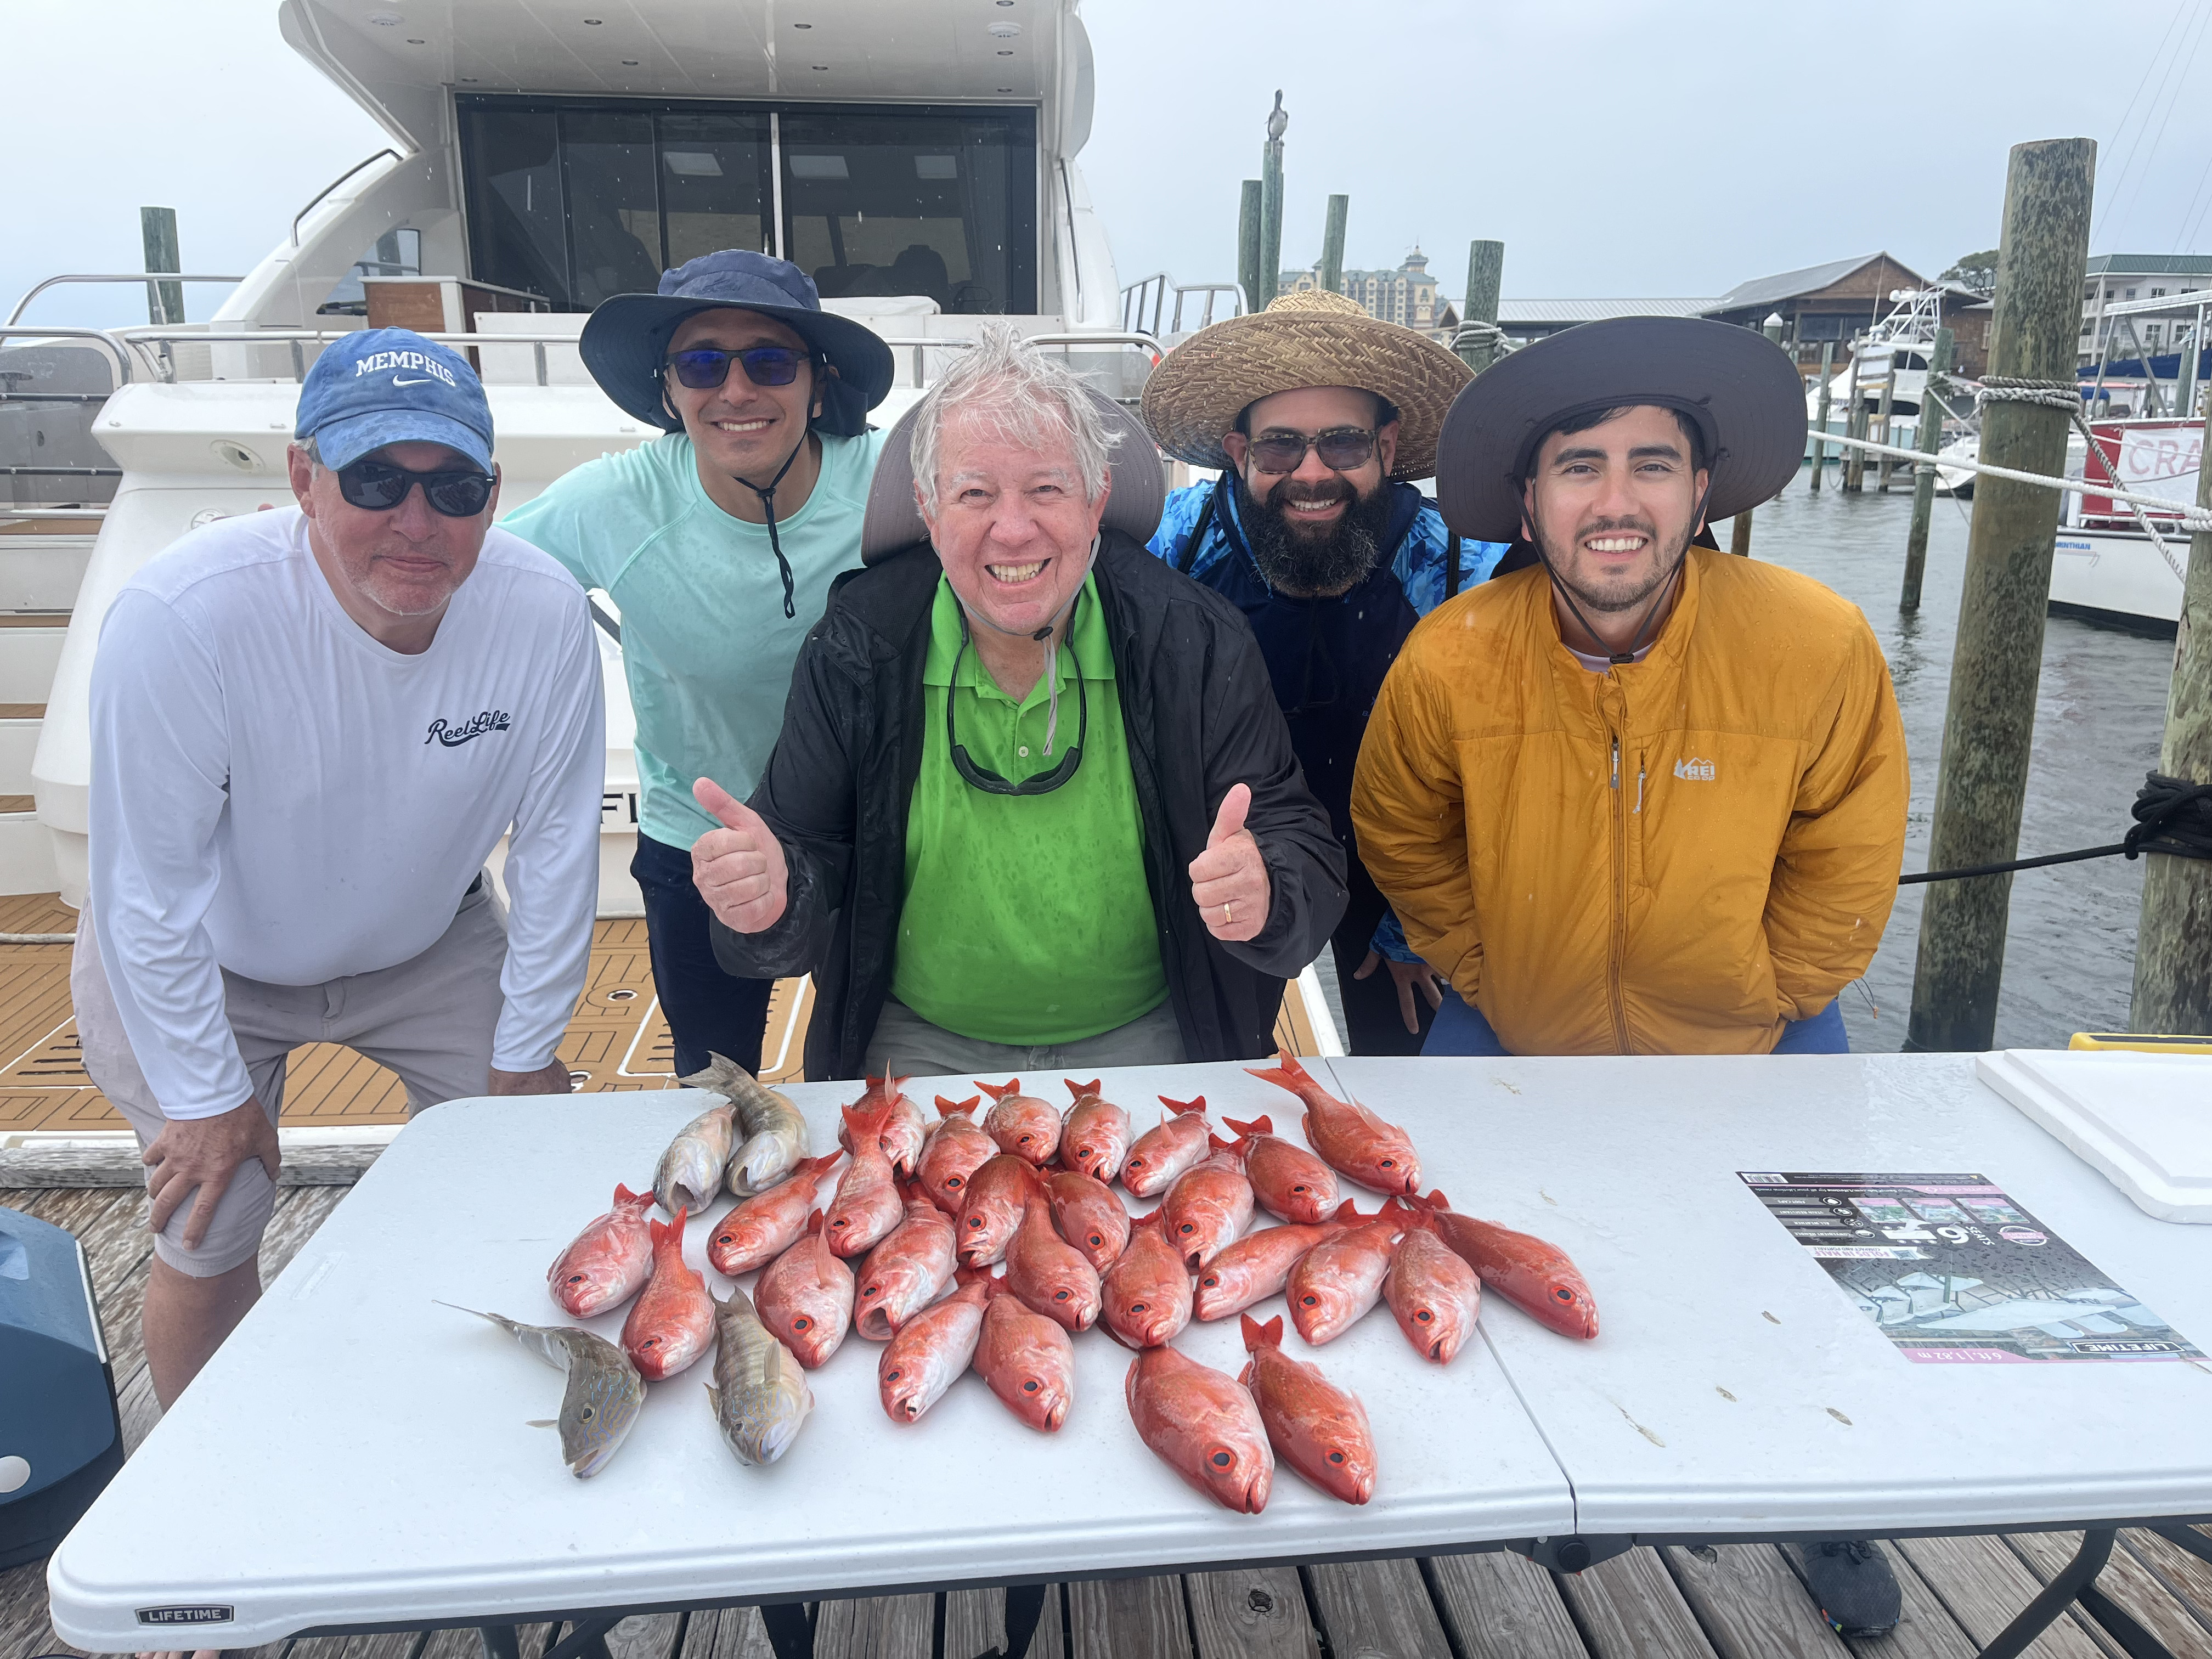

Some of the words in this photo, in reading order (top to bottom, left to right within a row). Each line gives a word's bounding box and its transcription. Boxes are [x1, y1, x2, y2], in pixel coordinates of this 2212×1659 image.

[356, 351, 456, 387] MEMPHIS
[1688, 765, 1716, 776] REI
[1937, 1226, 1970, 1244] 6
[1965, 1226, 1995, 1245] SEATS
[2084, 1343, 2170, 1351] LIFETIME
[148, 1609, 222, 1622] LIFETIME
